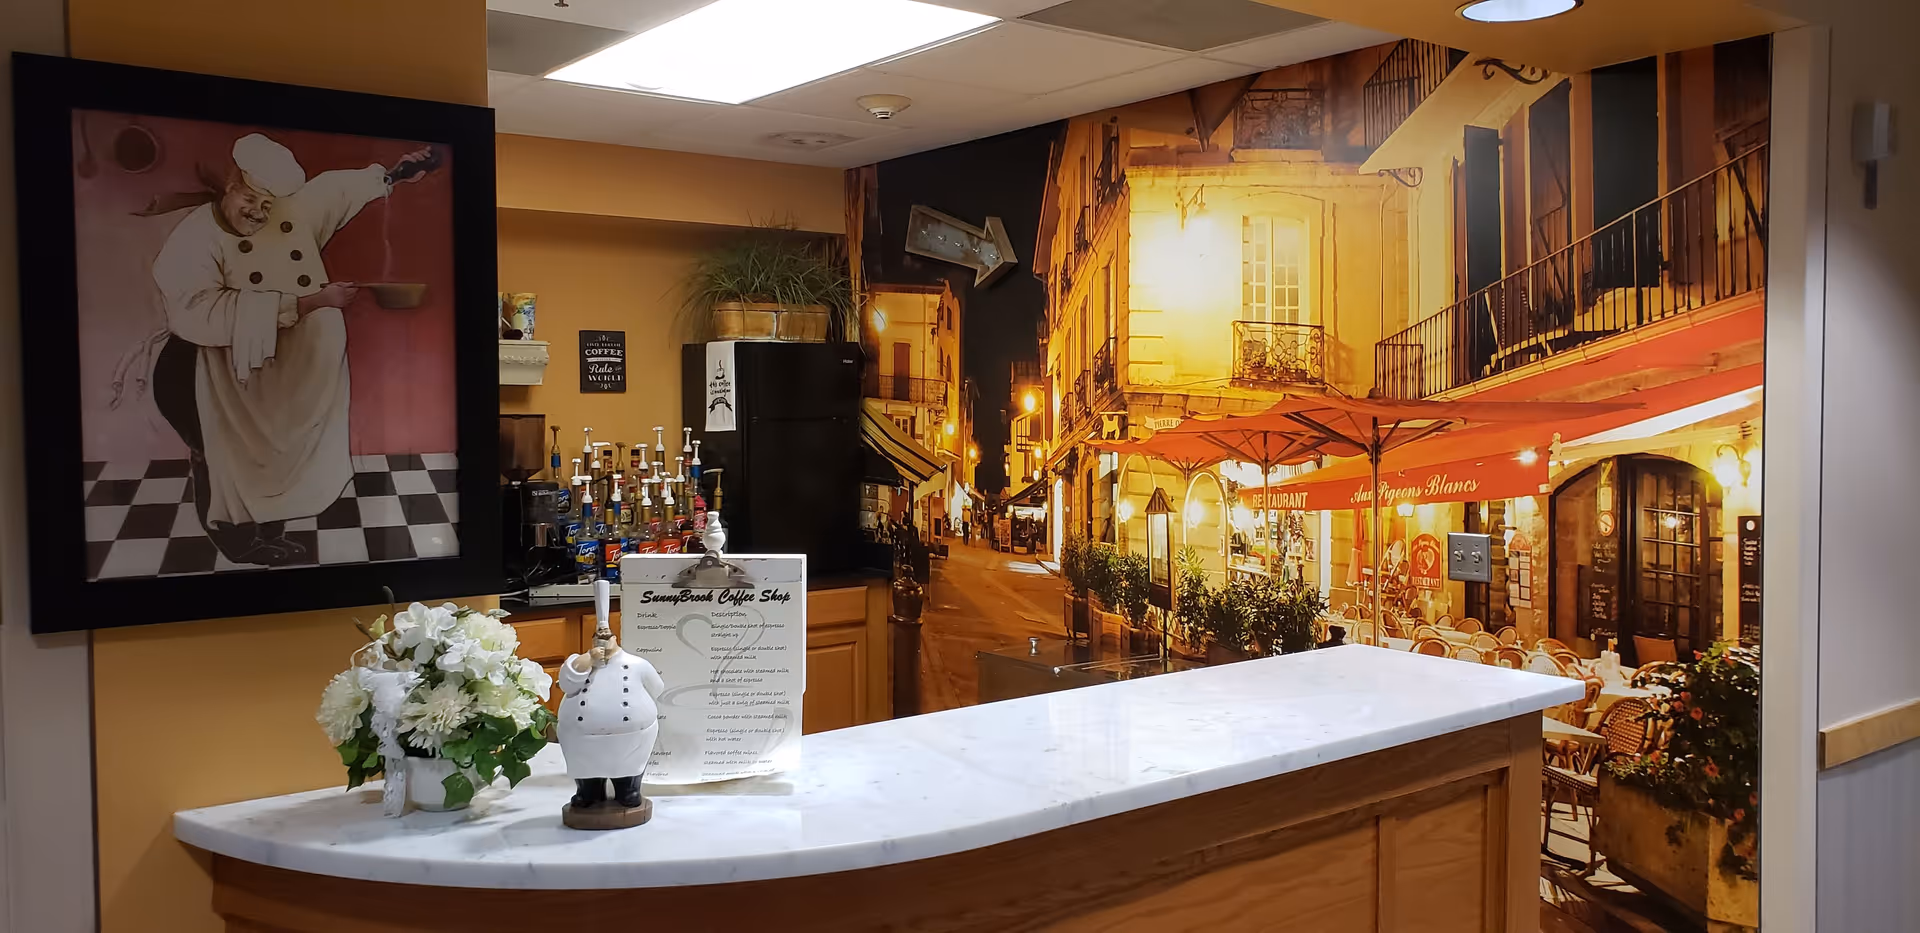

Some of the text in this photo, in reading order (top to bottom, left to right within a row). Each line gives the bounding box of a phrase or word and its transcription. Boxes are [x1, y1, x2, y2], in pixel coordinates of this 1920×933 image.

[584, 348, 624, 357] COFFEE
[588, 363, 614, 374] Rule
[1154, 419, 1174, 429] PIERRE
[1350, 474, 1481, 507] Aux Pigeons Blancs
[1252, 492, 1309, 509] RETAURANT
[640, 588, 791, 606] SunnyBrook Coffee Shop
[711, 611, 747, 619] Description
